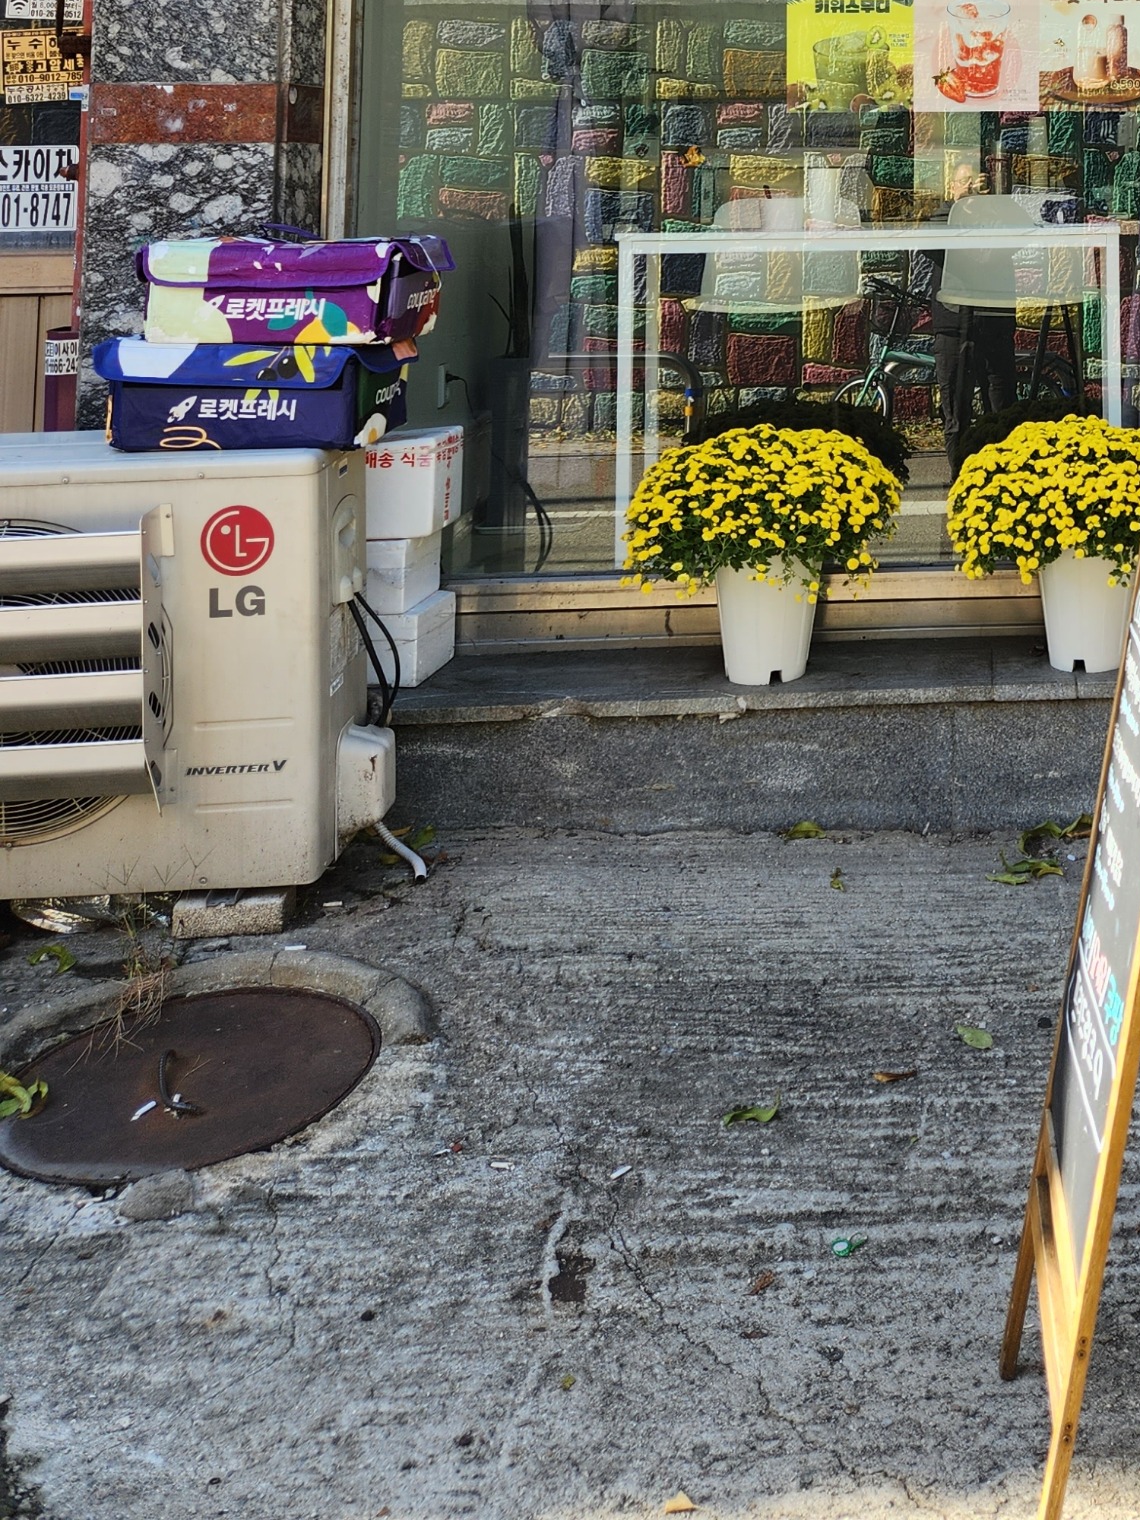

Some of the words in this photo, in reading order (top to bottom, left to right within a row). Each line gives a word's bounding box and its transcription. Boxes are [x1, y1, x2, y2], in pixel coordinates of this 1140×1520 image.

[815, 0, 890, 13] 키위스무디
[1, 193, 71, 227] 01-8747
[222, 298, 326, 321] 로켓프레시
[198, 399, 297, 421] 로켓프레시
[209, 585, 265, 618] LG
[185, 764, 269, 776] INVERTER
[273, 759, 287, 771] V
